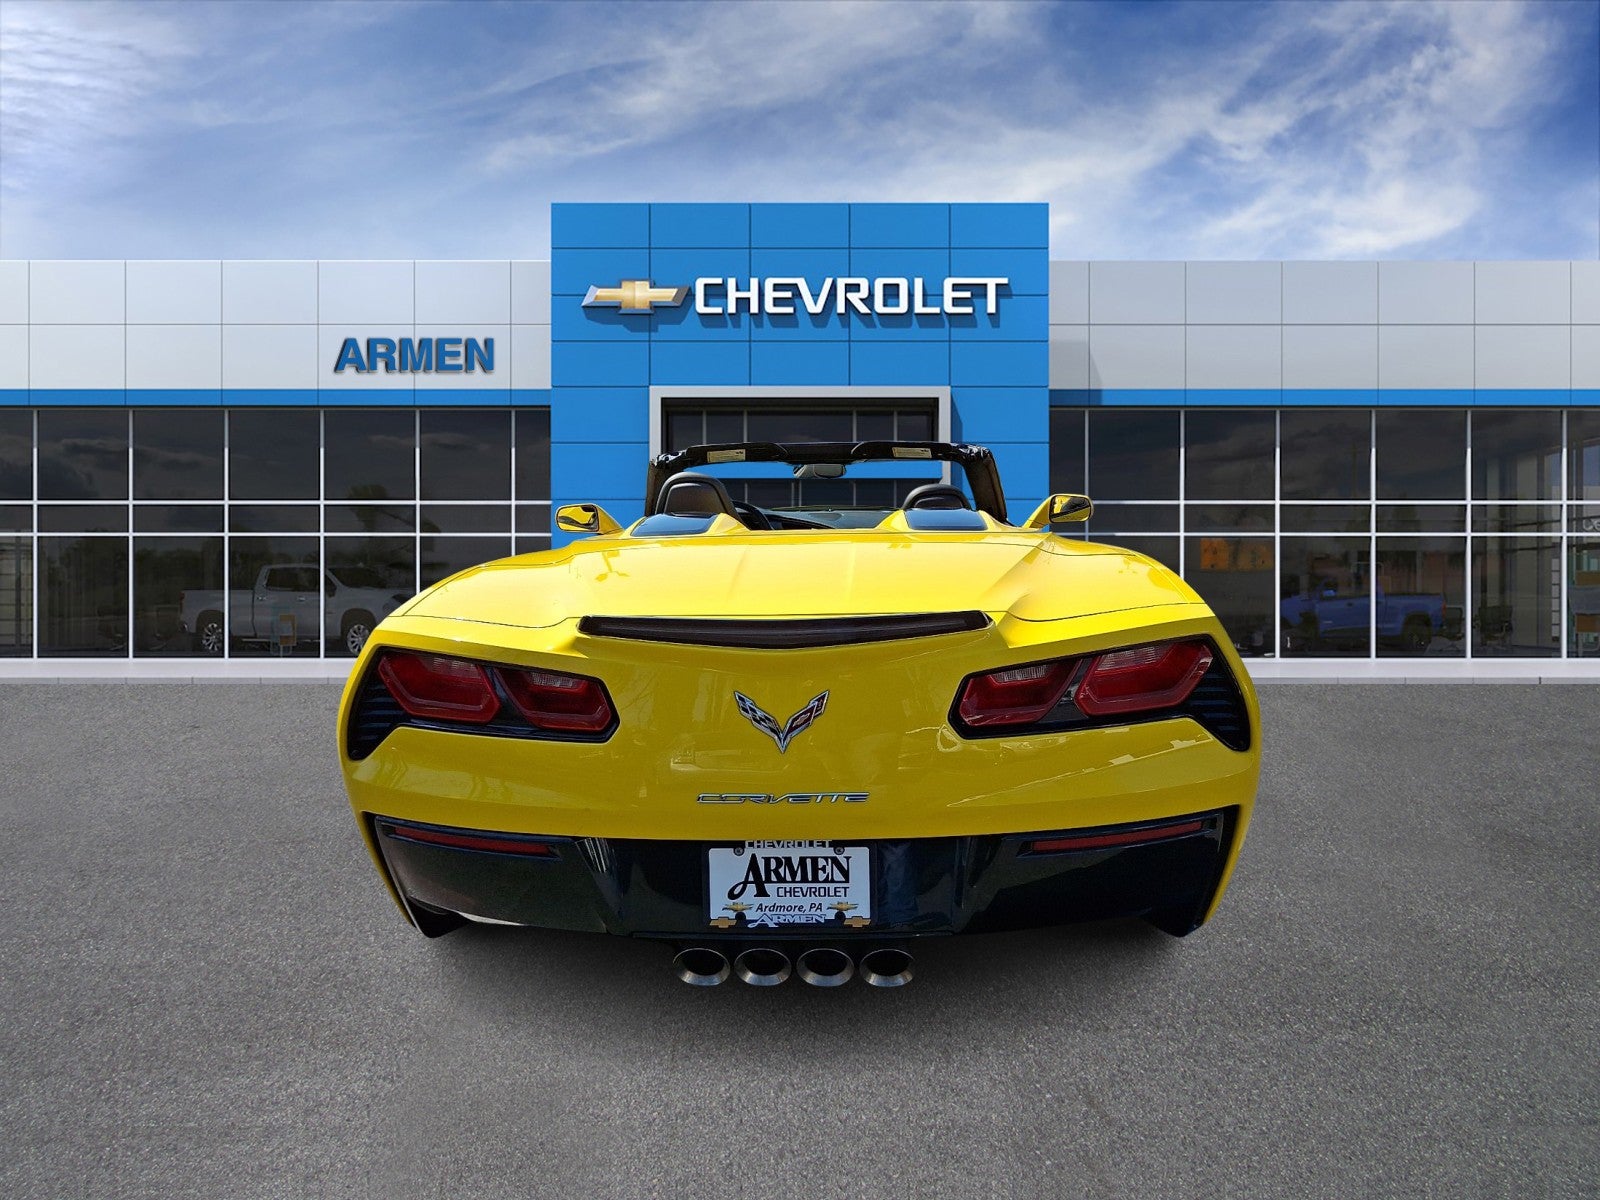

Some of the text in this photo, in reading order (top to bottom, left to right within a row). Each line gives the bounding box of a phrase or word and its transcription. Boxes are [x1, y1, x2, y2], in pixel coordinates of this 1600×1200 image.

[694, 277, 1009, 315] CHEVROLET
[334, 337, 495, 373] ARMEN
[697, 792, 870, 804] CORVETTE
[744, 839, 832, 849] CHEVROLET
[727, 852, 852, 901] ARMEN
[776, 886, 849, 898] CHEVROLET
[755, 902, 823, 913] Ardmore, PA
[747, 913, 826, 928] ARMEN
